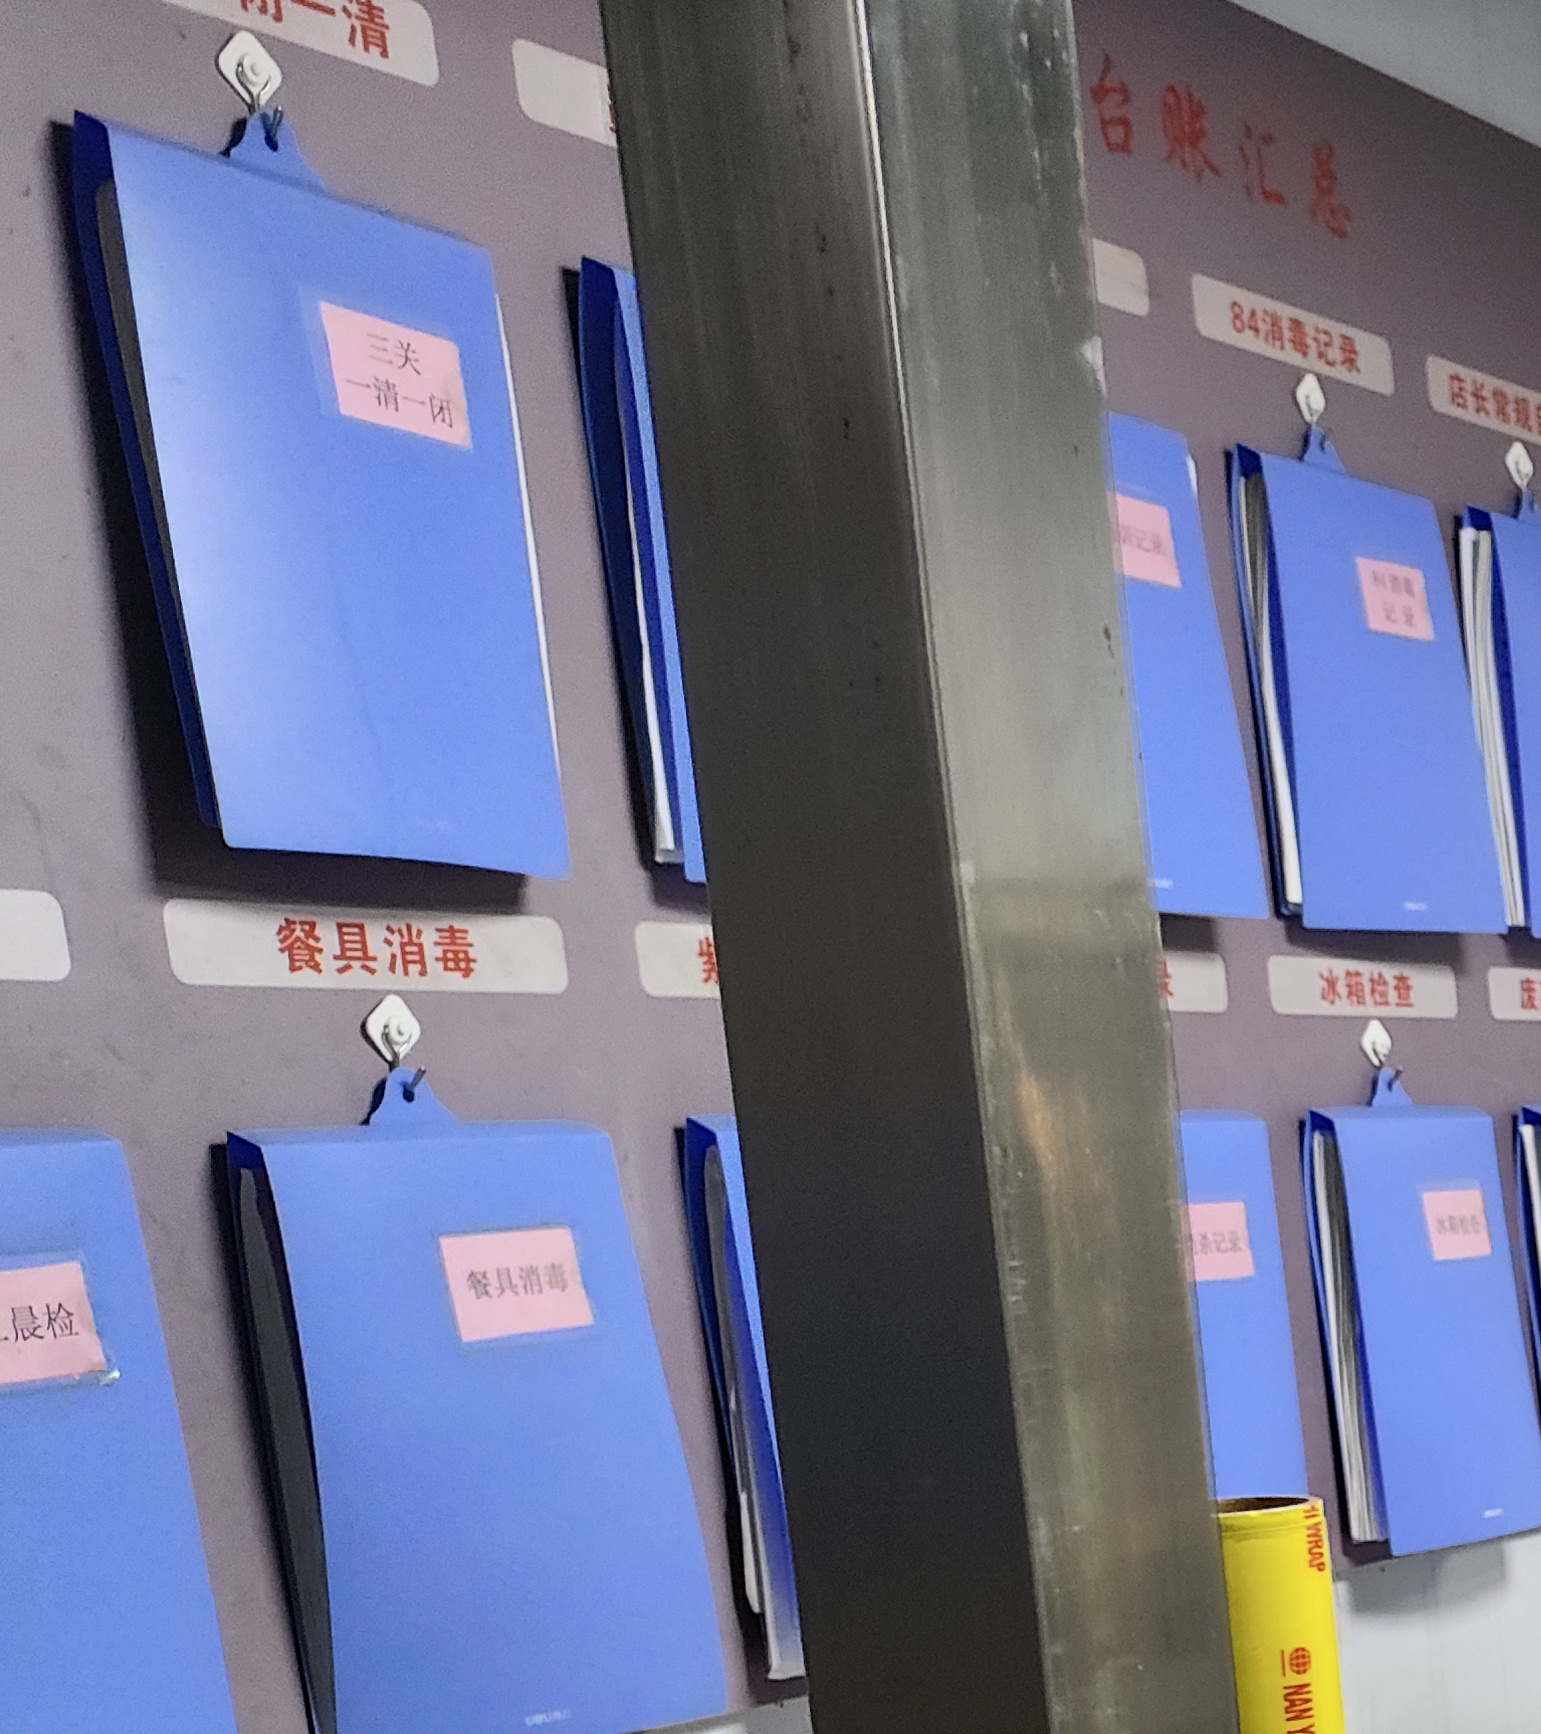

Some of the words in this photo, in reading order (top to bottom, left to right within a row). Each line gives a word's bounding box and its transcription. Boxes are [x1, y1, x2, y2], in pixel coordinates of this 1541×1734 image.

[1090, 52, 1352, 240] 台账汇总
[366, 333, 421, 375] 三关
[1231, 300, 1361, 374] 84消毒记录
[346, 376, 453, 428] 一清一闭
[275, 917, 478, 980] 餐具消毒
[1318, 969, 1416, 1009] 冰箱检查
[467, 1264, 571, 1301] 餐具消毒
[1306, 1521, 1326, 1573] WRAP
[1283, 1683, 1314, 1723] NAN
